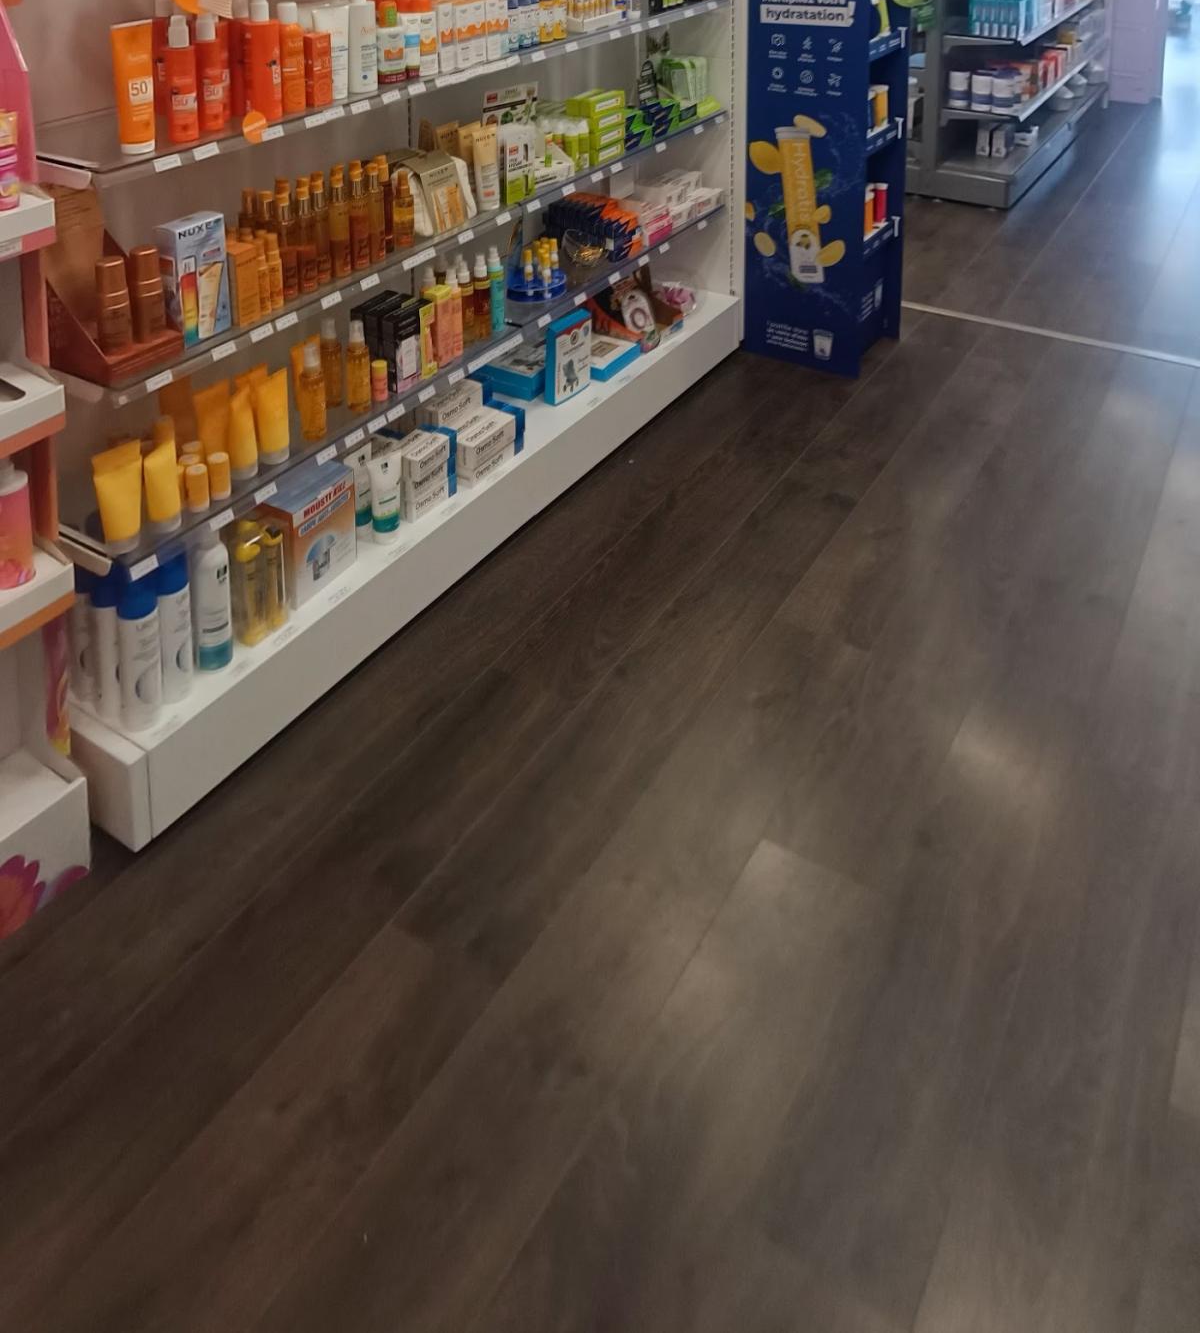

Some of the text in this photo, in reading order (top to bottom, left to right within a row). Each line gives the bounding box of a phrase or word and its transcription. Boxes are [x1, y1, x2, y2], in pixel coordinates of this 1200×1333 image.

[766, 7, 845, 22] hydratation
[178, 220, 213, 241] NUXE
[442, 396, 472, 420] Osmo Soft
[475, 441, 492, 455] Osmo
[419, 453, 434, 469] Osmo
[475, 465, 492, 479] Osmo
[415, 495, 432, 510] Osmo
